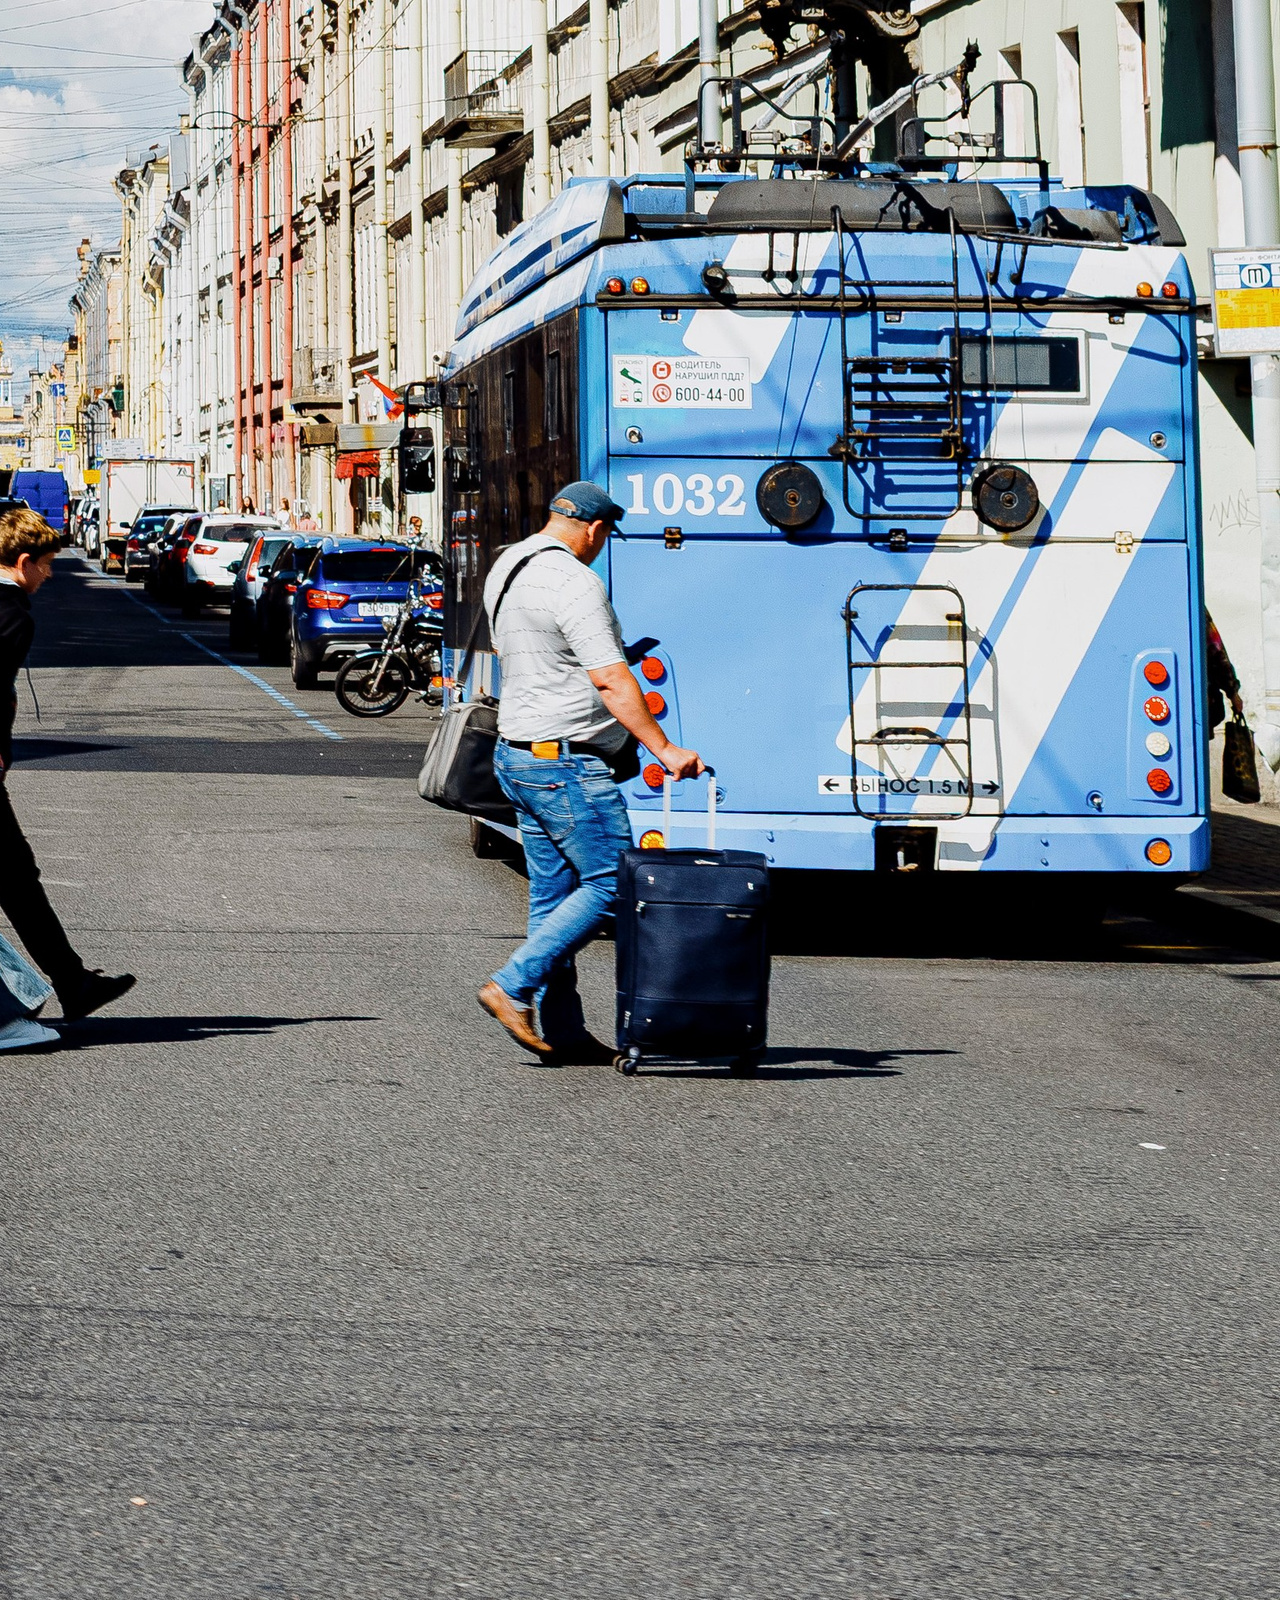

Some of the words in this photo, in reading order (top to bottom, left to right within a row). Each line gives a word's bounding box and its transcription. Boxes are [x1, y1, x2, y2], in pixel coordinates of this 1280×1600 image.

[675, 361, 721, 370] ВОДИТЕЛЬ
[675, 372, 719, 380] НАРУШИЛ
[721, 373, 745, 381] ПДД?
[675, 387, 745, 402] 600-44-00
[626, 473, 747, 516] 1032
[928, 779, 952, 794] 1.5
